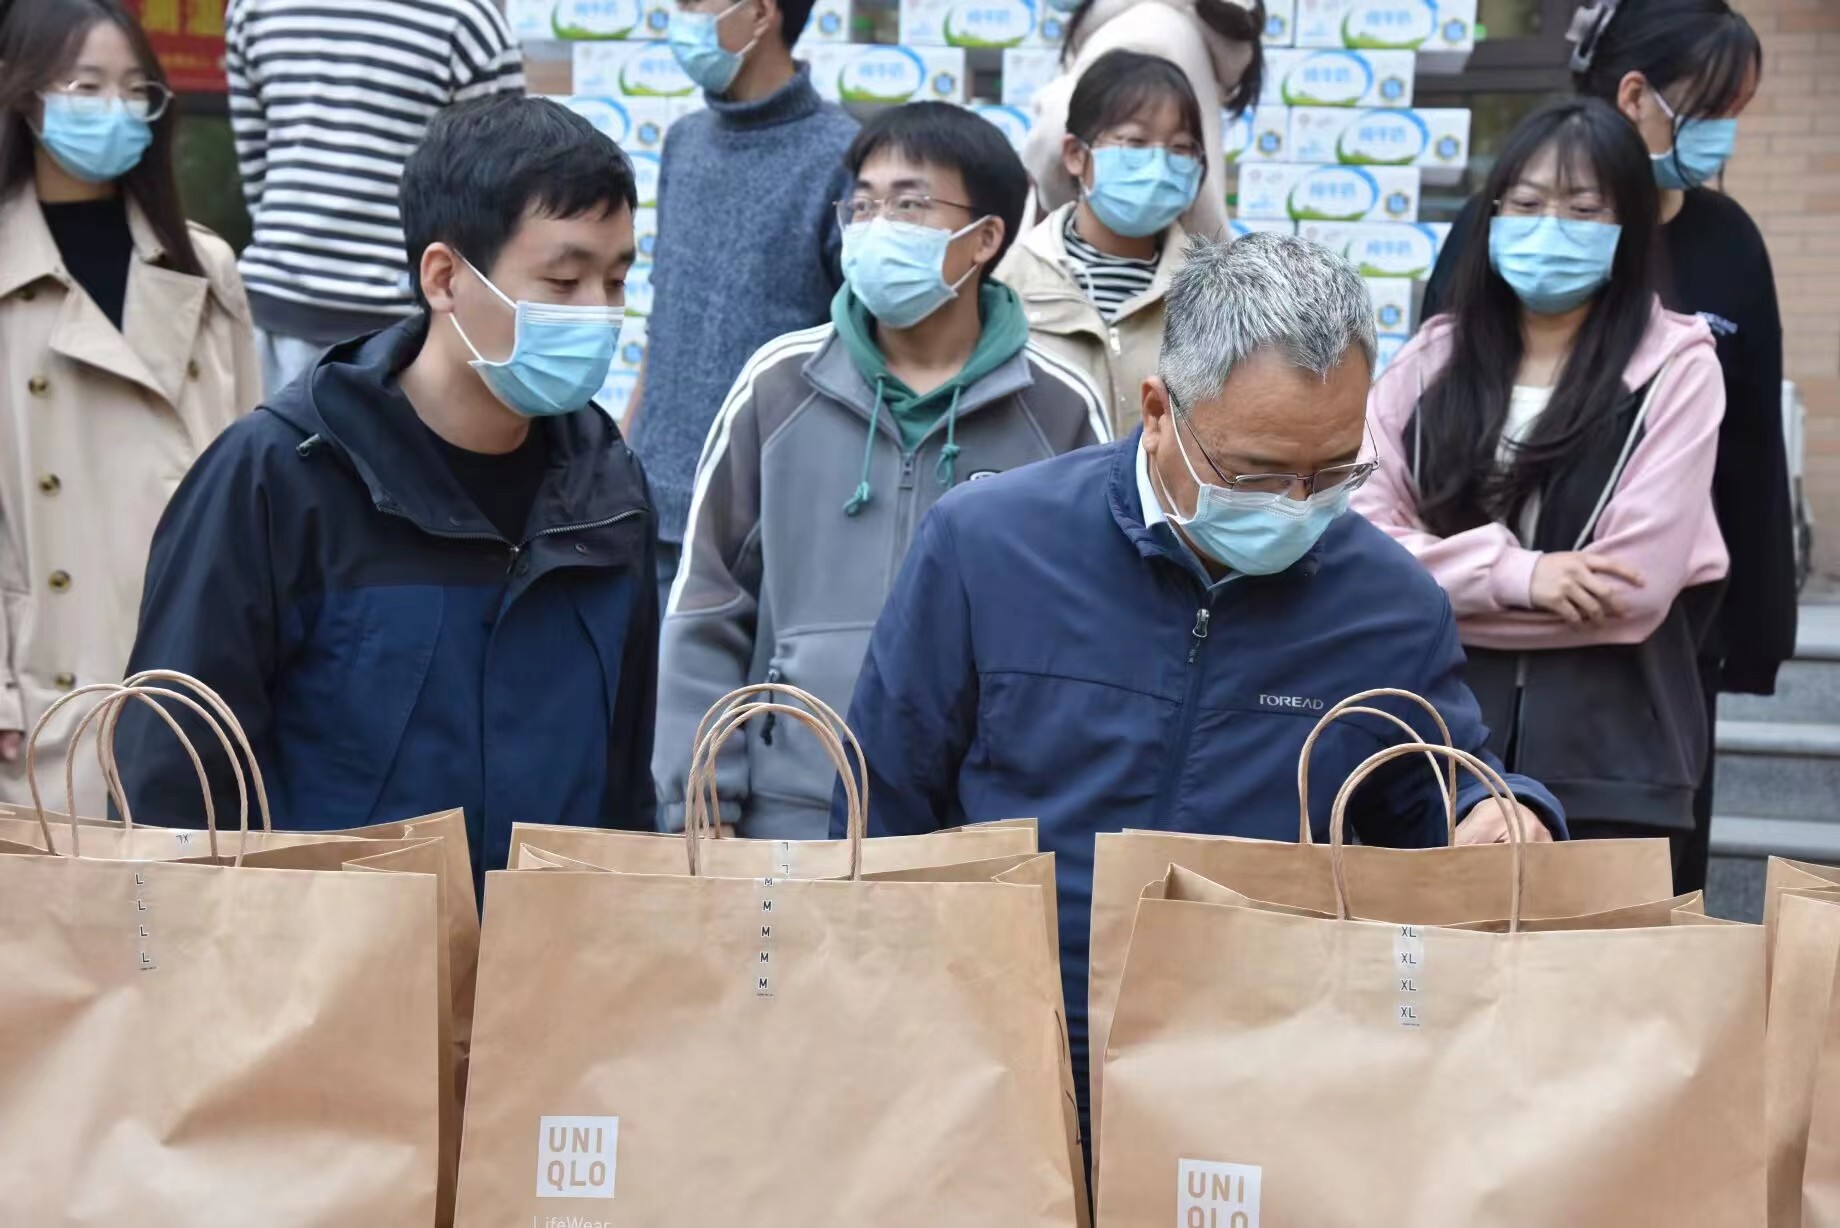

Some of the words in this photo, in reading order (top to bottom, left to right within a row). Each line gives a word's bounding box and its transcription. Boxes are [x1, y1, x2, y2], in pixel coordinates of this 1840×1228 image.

[1259, 694, 1324, 710] TOREAD
[136, 874, 144, 885] L
[138, 901, 146, 911] L
[763, 901, 772, 912] M
[140, 926, 149, 937] L
[761, 926, 770, 937] M
[1401, 926, 1417, 938] XL
[142, 953, 150, 963] L
[760, 952, 769, 963] M
[1401, 953, 1417, 965] XL
[759, 978, 768, 989] M
[1401, 980, 1417, 992] XL
[1401, 1007, 1416, 1018] XL
[548, 1126, 603, 1153] UNI
[547, 1160, 606, 1191] QLO
[1187, 1171, 1245, 1204] UNI
